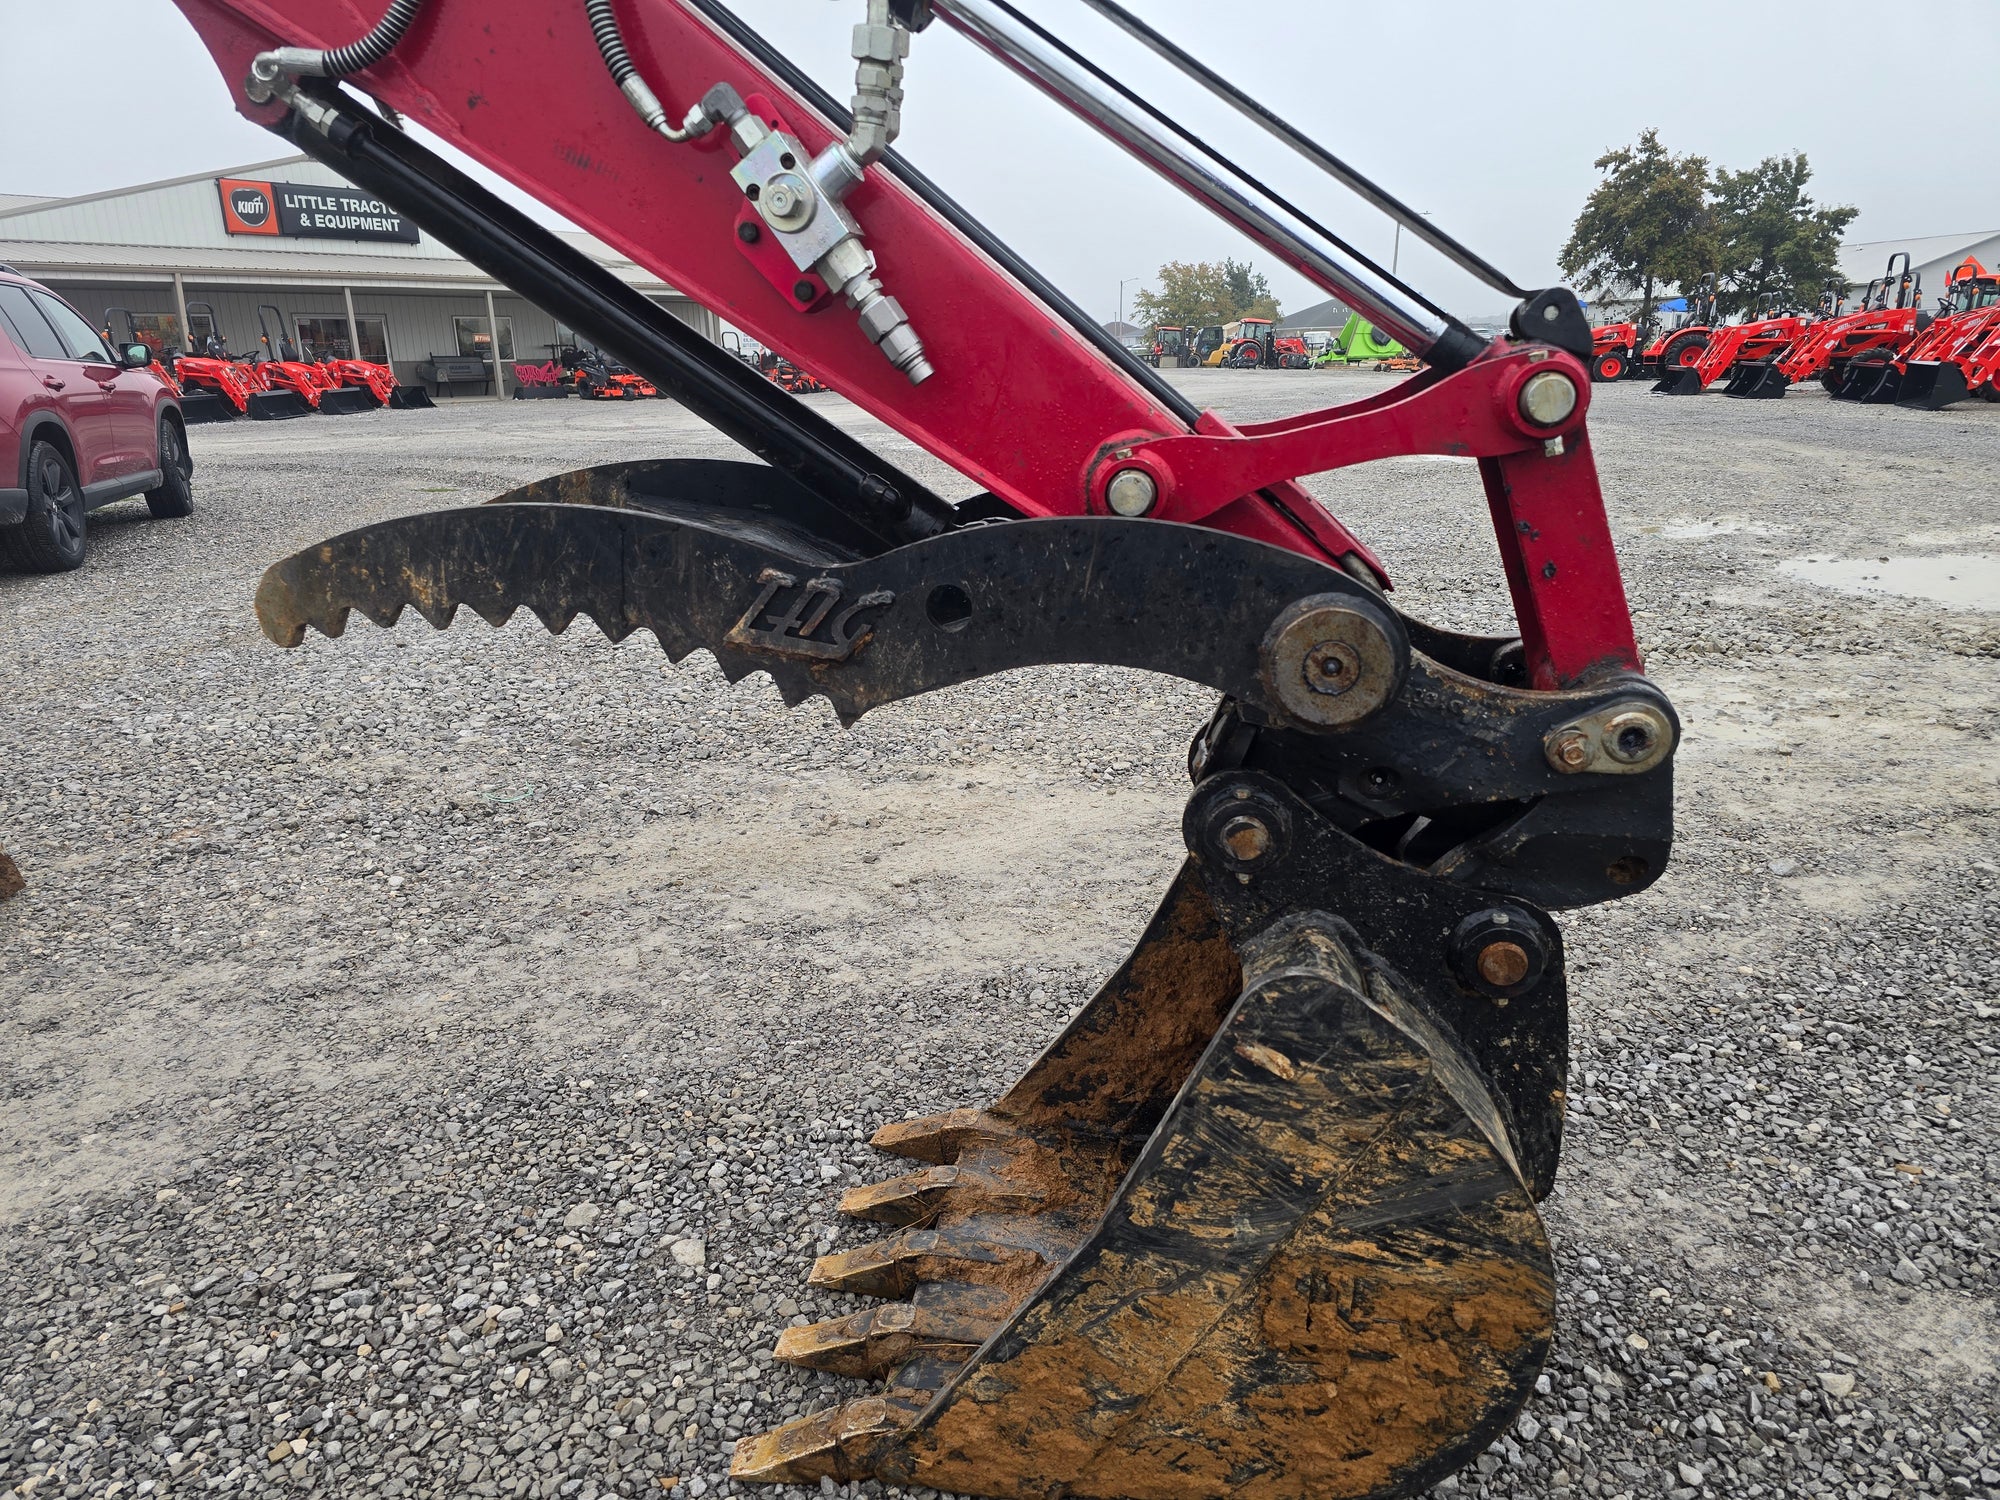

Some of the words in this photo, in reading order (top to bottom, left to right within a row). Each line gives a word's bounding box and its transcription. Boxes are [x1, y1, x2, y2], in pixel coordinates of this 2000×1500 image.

[237, 198, 264, 214] KIOTI
[284, 194, 338, 211] LITTLE
[340, 198, 398, 215] TRACT
[300, 213, 312, 227] &
[314, 213, 400, 232] EQUIPMENT
